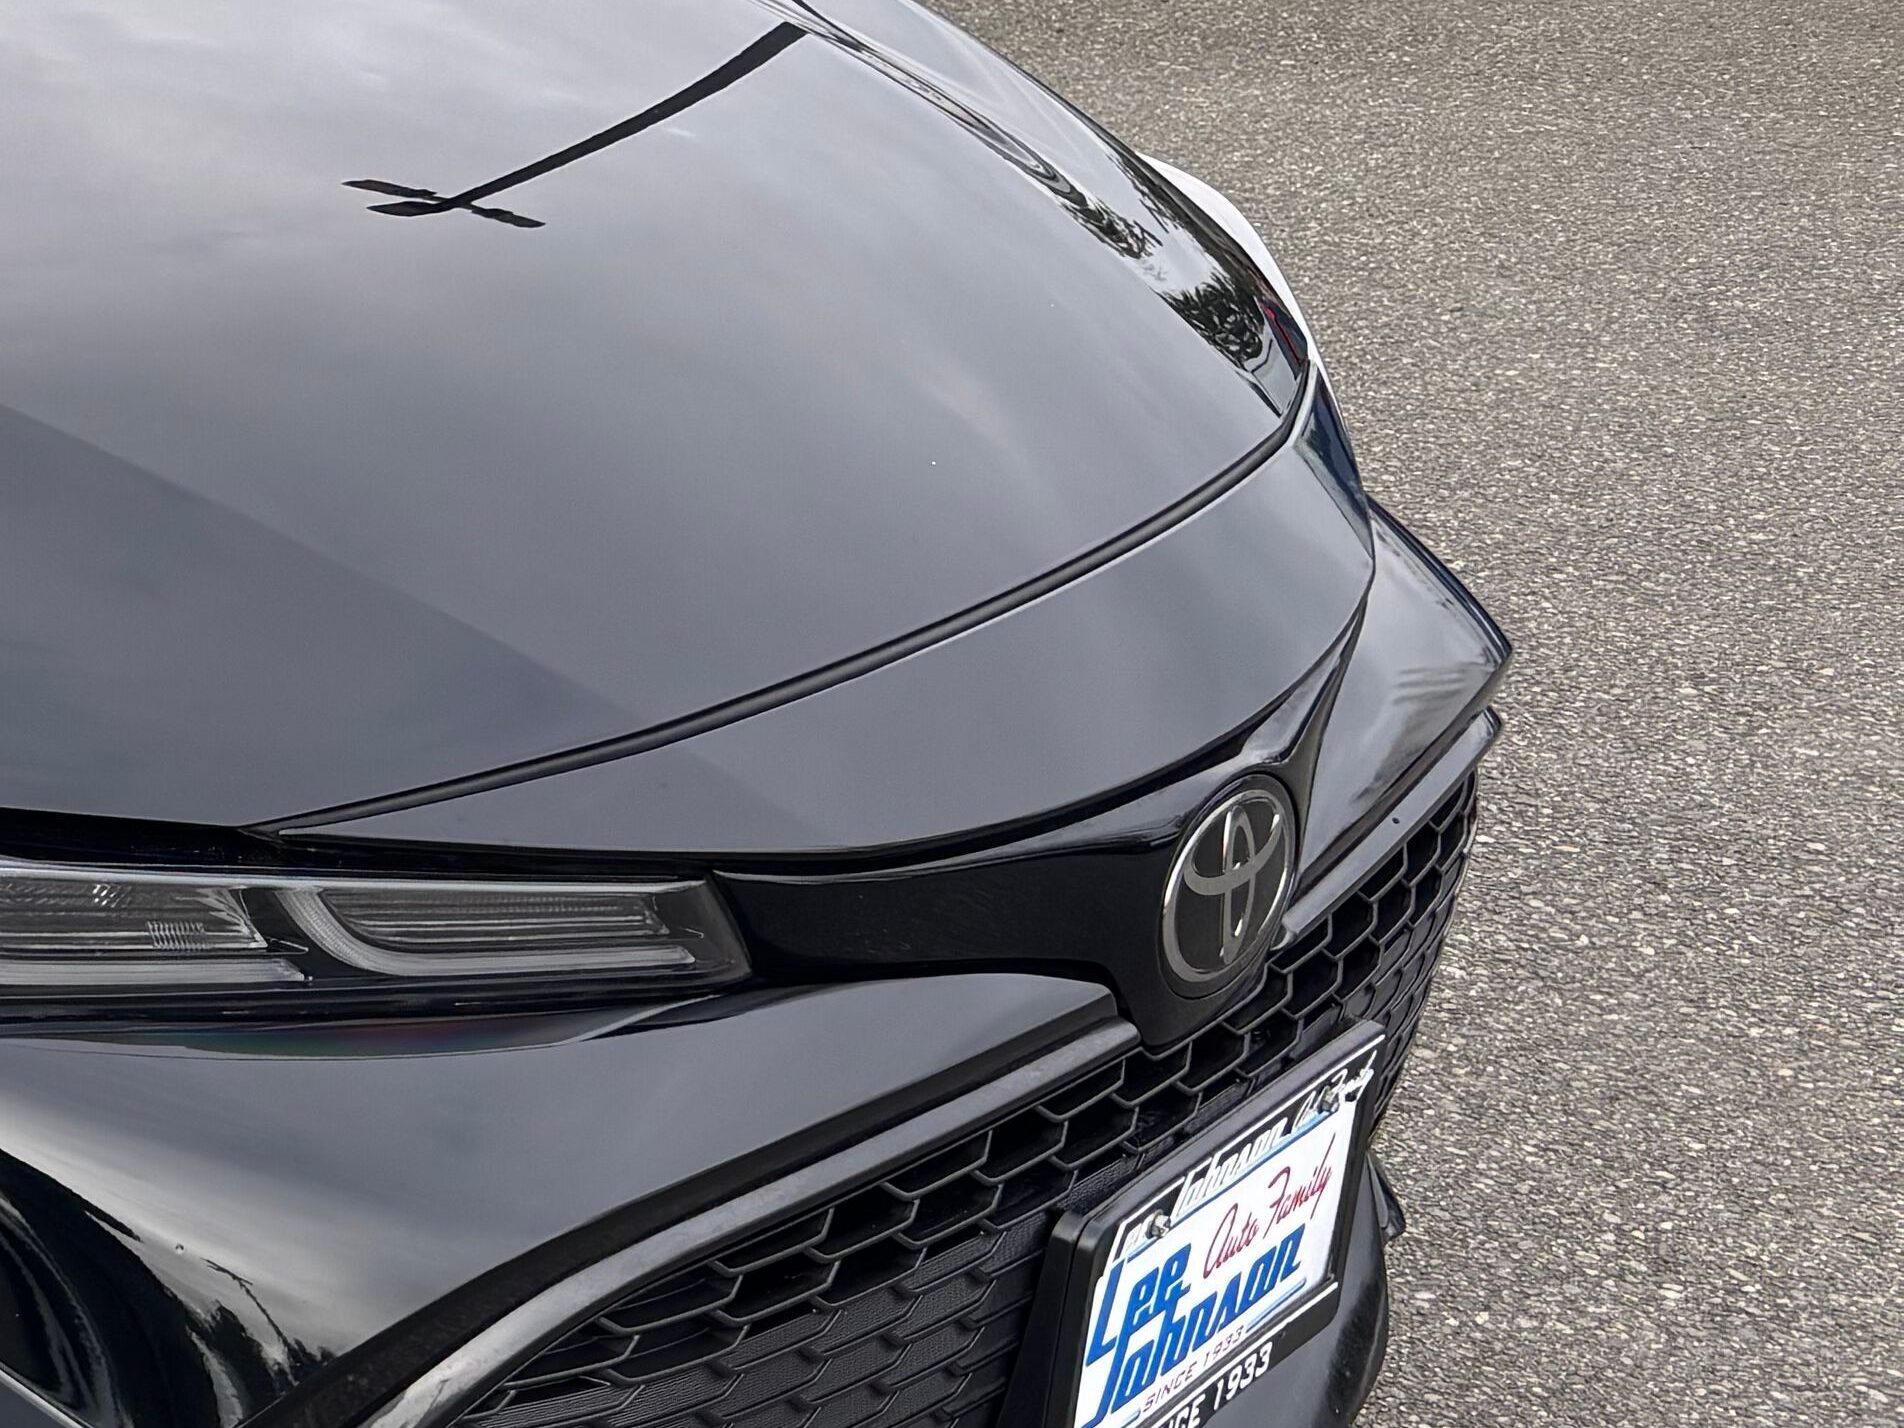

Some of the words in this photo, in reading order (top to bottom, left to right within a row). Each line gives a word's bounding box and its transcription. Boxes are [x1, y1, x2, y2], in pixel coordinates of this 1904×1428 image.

[1202, 1203, 1259, 1279] Auto
[1263, 1132, 1336, 1238] Family
[1085, 1241, 1192, 1367] Lee
[1141, 1364, 1195, 1414] SINCE
[1201, 1326, 1245, 1367] 1933
[1213, 1341, 1274, 1408] 1933
